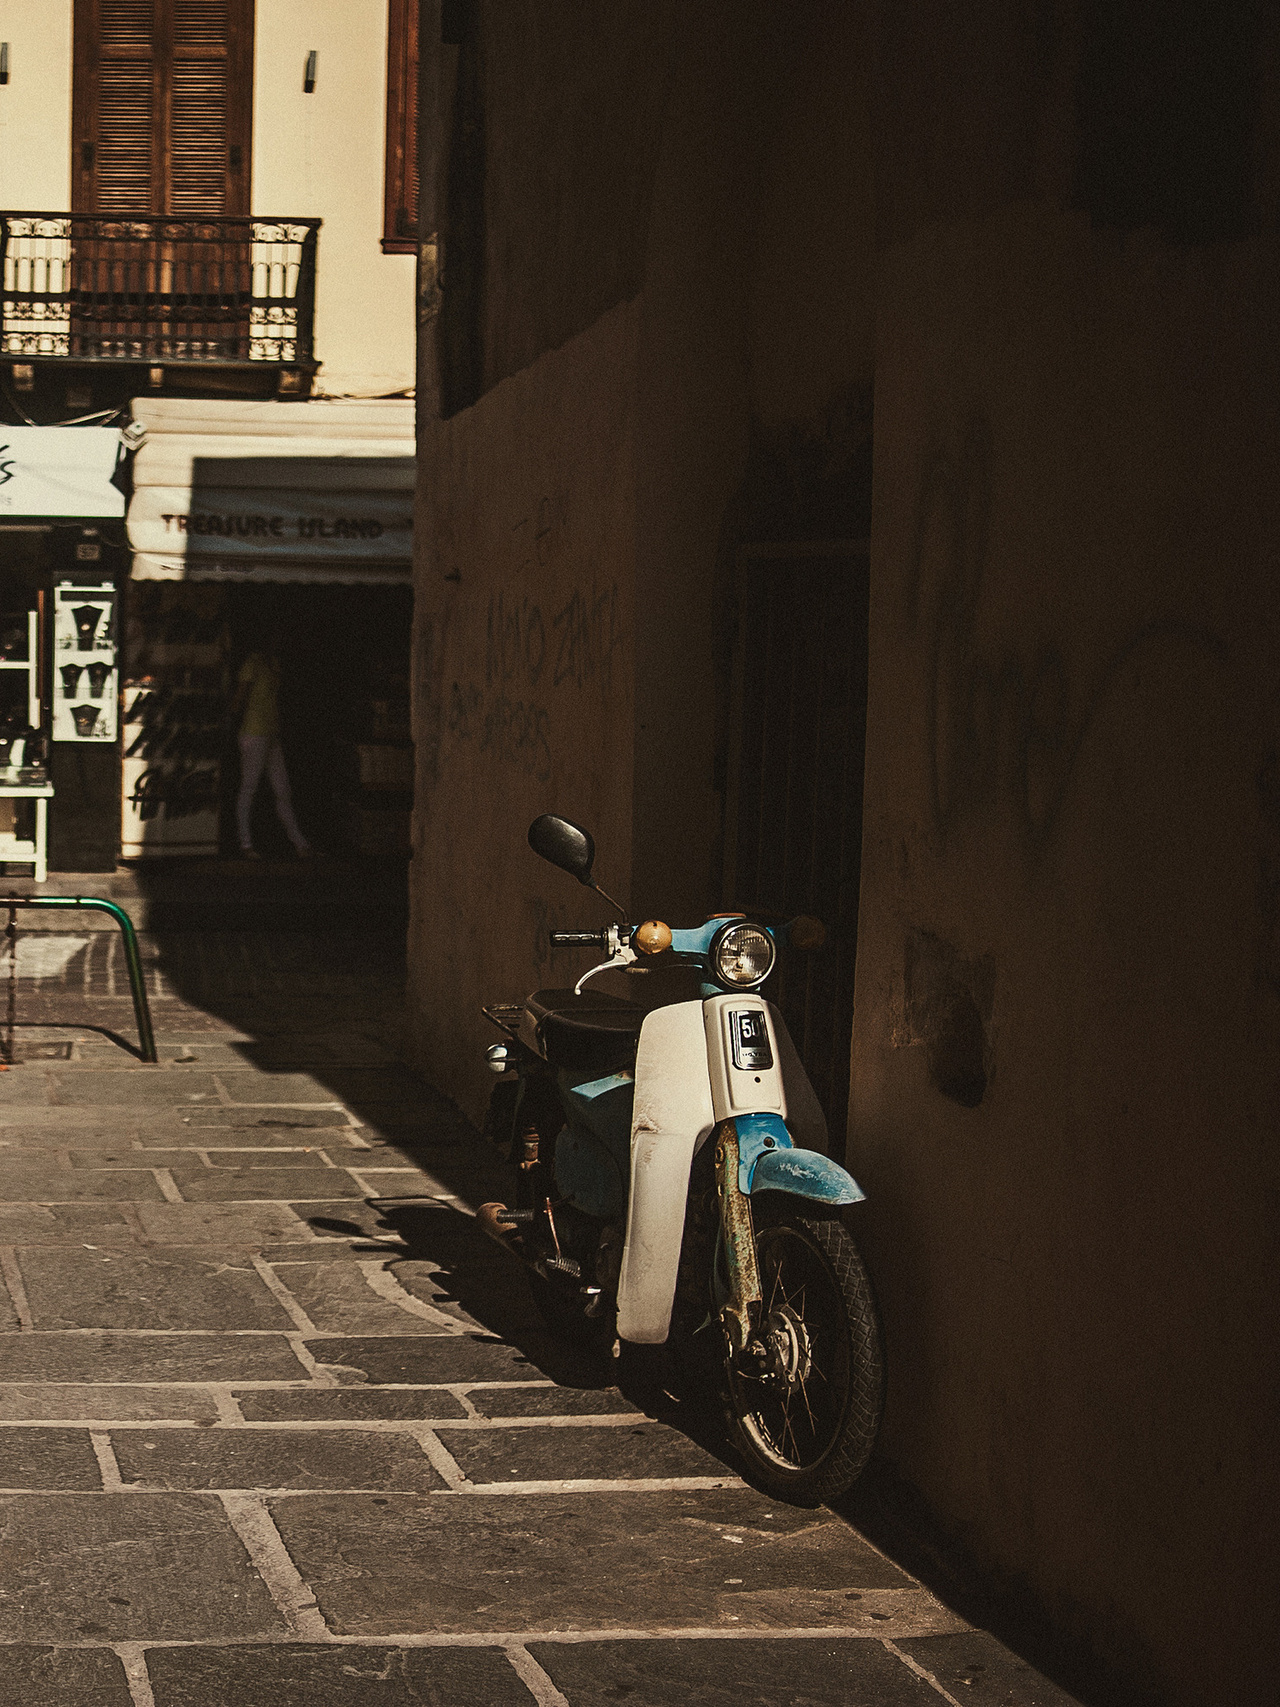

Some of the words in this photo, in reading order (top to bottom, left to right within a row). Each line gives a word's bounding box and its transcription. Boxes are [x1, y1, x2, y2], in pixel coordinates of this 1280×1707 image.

[161, 514, 285, 538] TREASURE
[299, 517, 385, 540] ISLAND
[741, 1018, 760, 1038] 50
